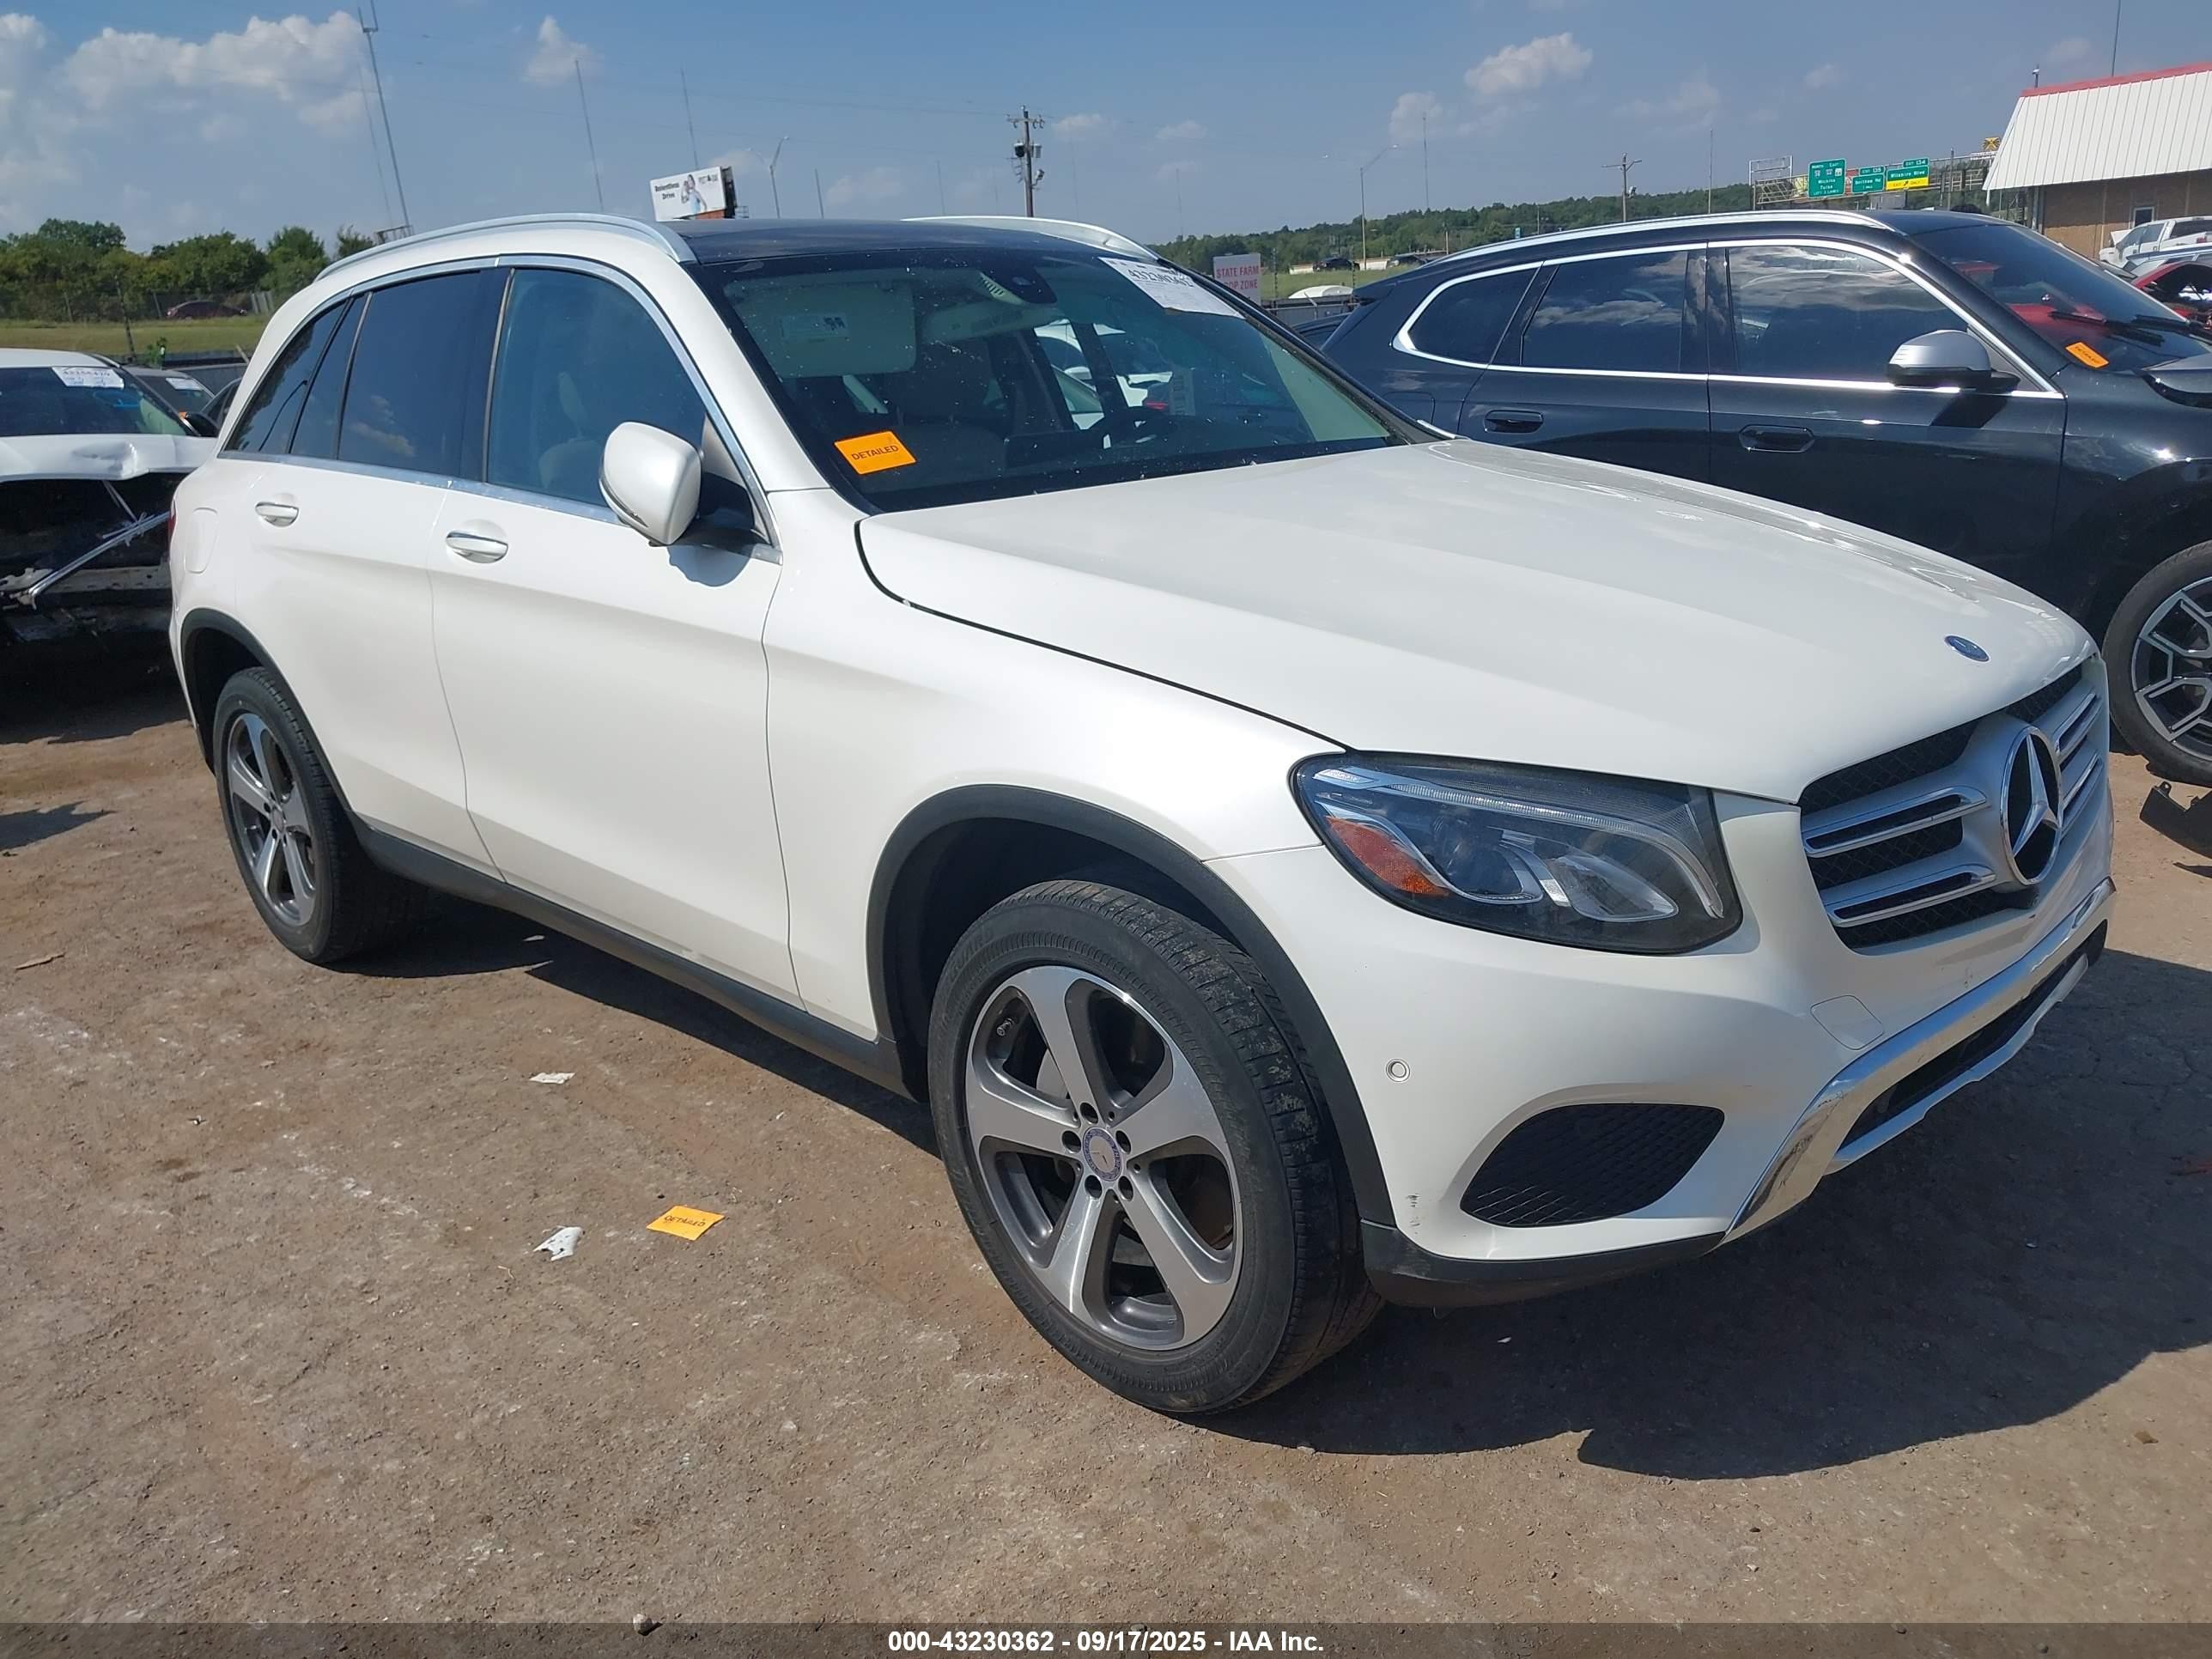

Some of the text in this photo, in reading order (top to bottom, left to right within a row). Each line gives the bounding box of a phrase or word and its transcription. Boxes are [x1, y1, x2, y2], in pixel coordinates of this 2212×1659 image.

[1216, 265, 1259, 278] STATE FARM
[1240, 278, 1258, 289] ZONE
[852, 445, 899, 460] DETAILED
